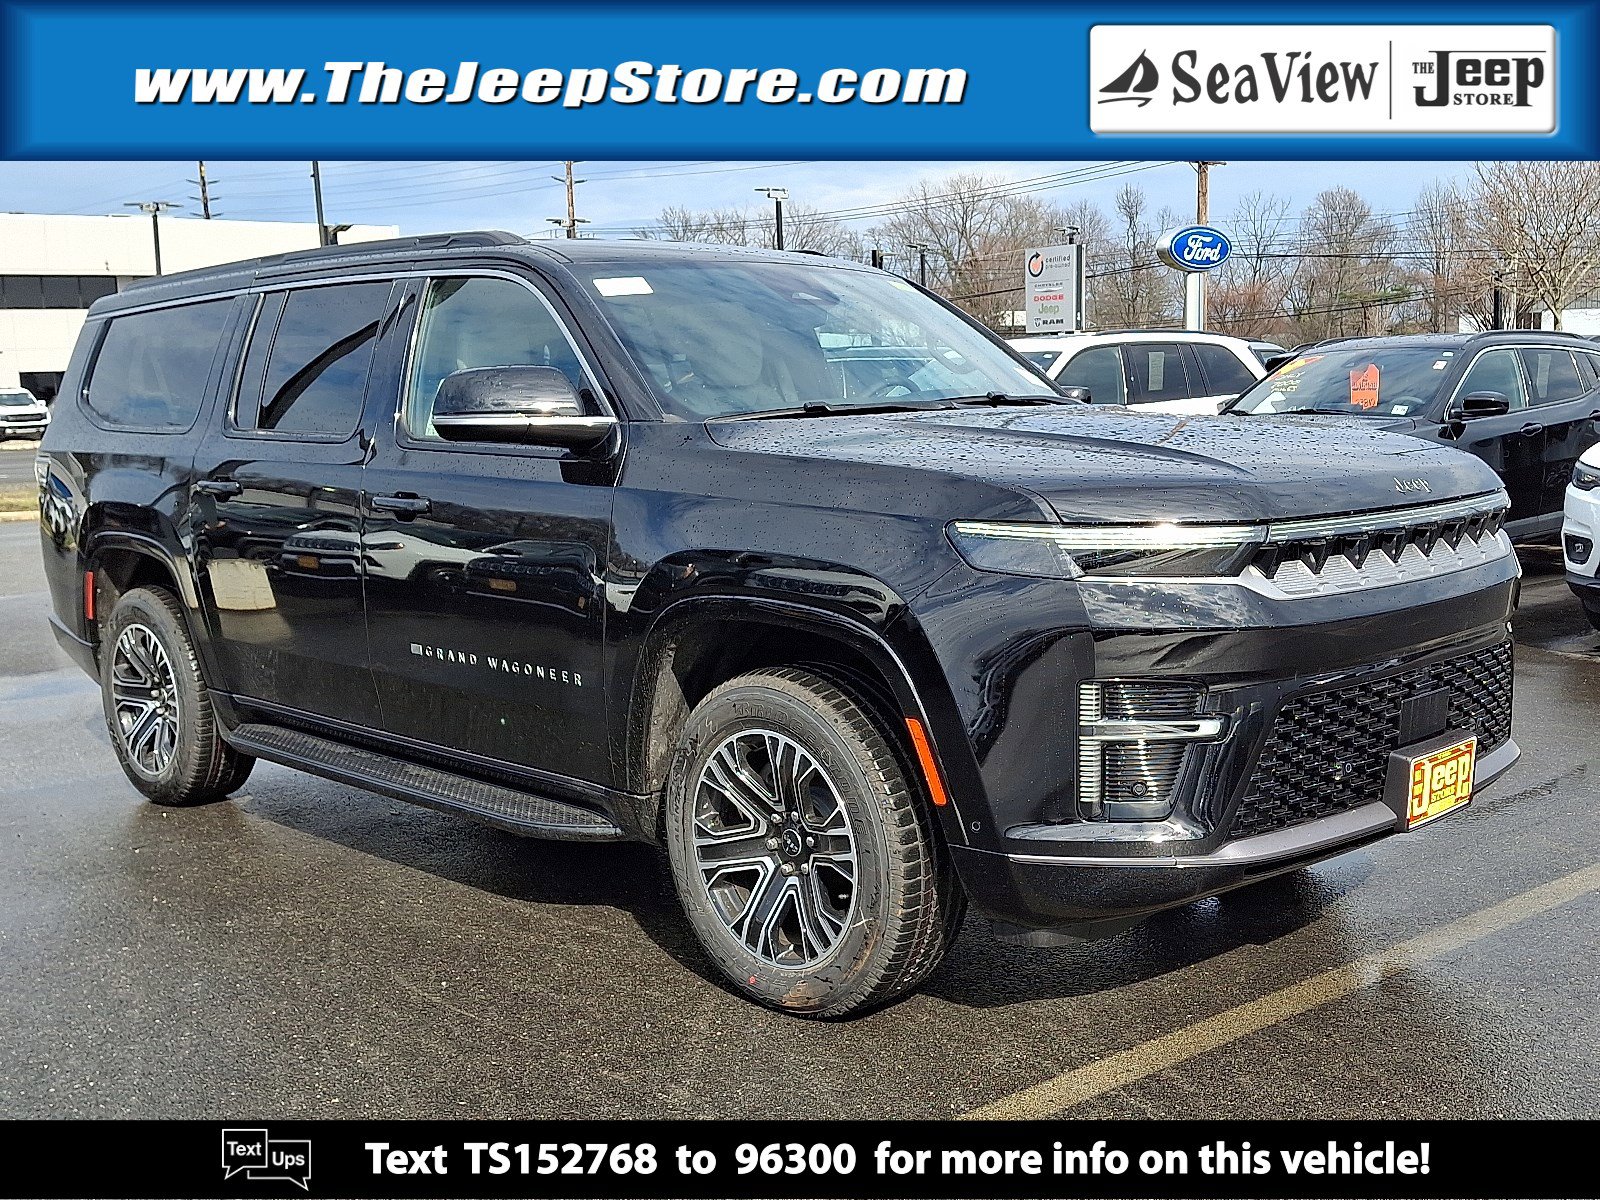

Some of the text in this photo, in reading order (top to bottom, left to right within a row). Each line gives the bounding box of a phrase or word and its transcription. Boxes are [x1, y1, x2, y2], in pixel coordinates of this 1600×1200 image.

[1183, 234, 1222, 262] Ford
[1045, 254, 1071, 263] certified
[1033, 294, 1064, 302] DODGE
[1038, 303, 1060, 315] Jeep
[1042, 318, 1064, 326] RAM
[1393, 477, 1432, 493] Jeep
[425, 646, 582, 687] GRAND WAGONEER
[1412, 753, 1471, 817] Jeep
